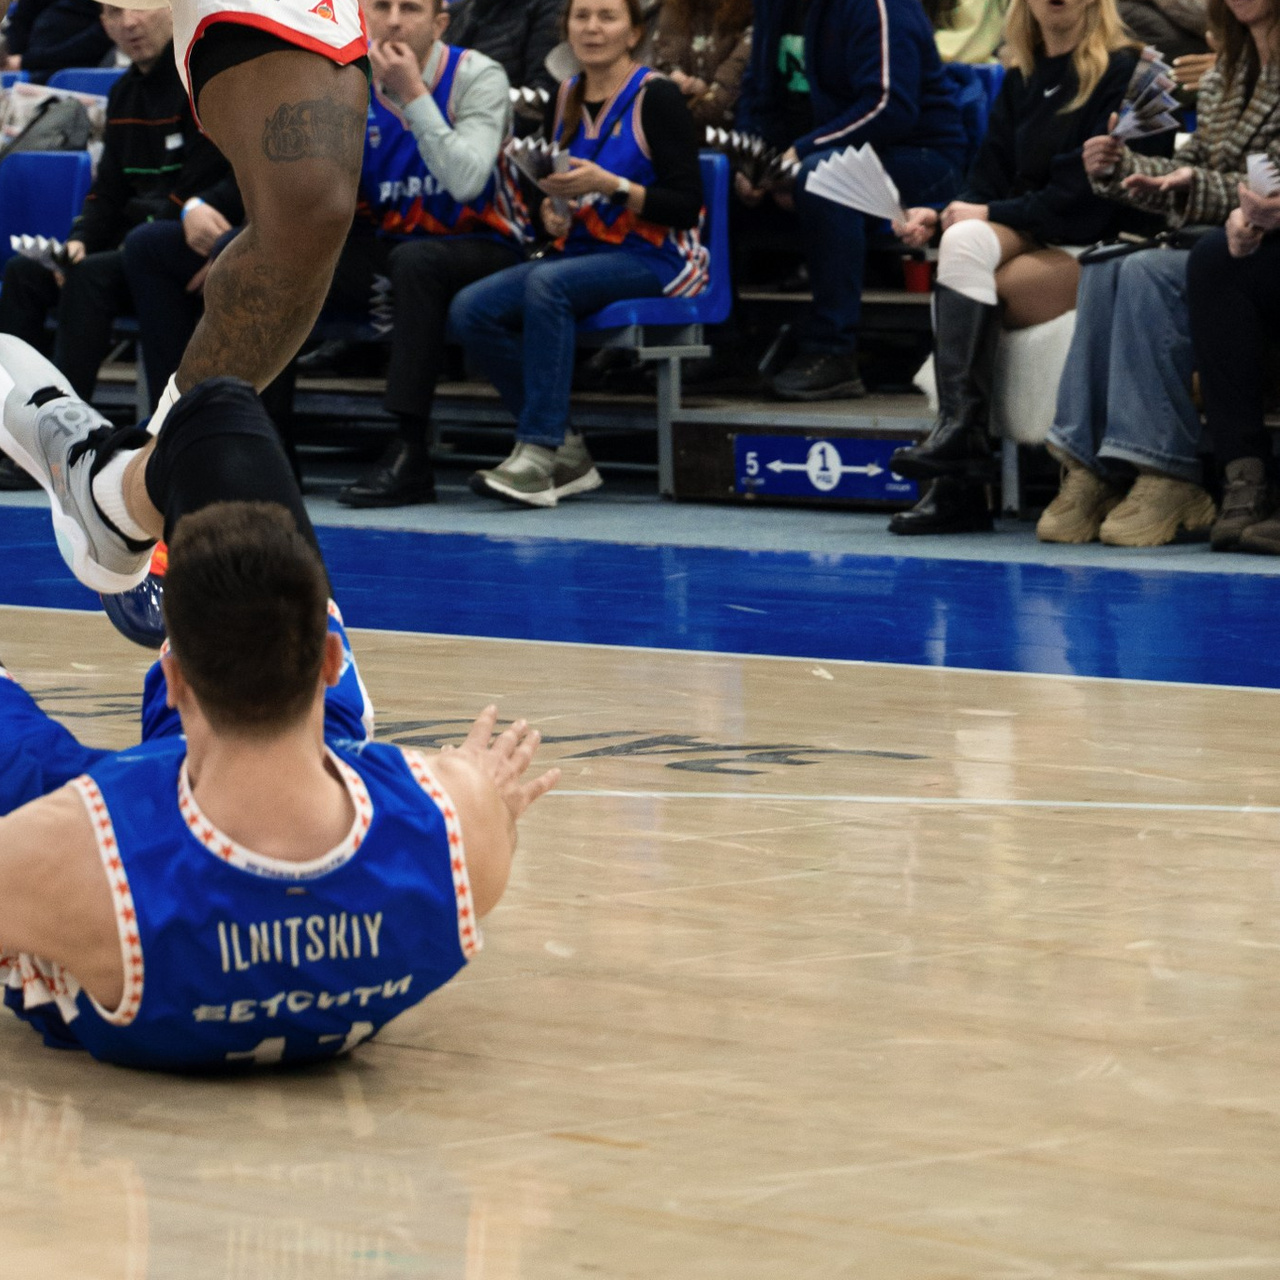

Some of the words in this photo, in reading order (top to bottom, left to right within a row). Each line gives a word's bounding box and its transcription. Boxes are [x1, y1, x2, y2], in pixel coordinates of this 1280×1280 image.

[745, 451, 759, 476] 5
[817, 446, 830, 472] 1
[217, 911, 383, 973] ILNITSKIY
